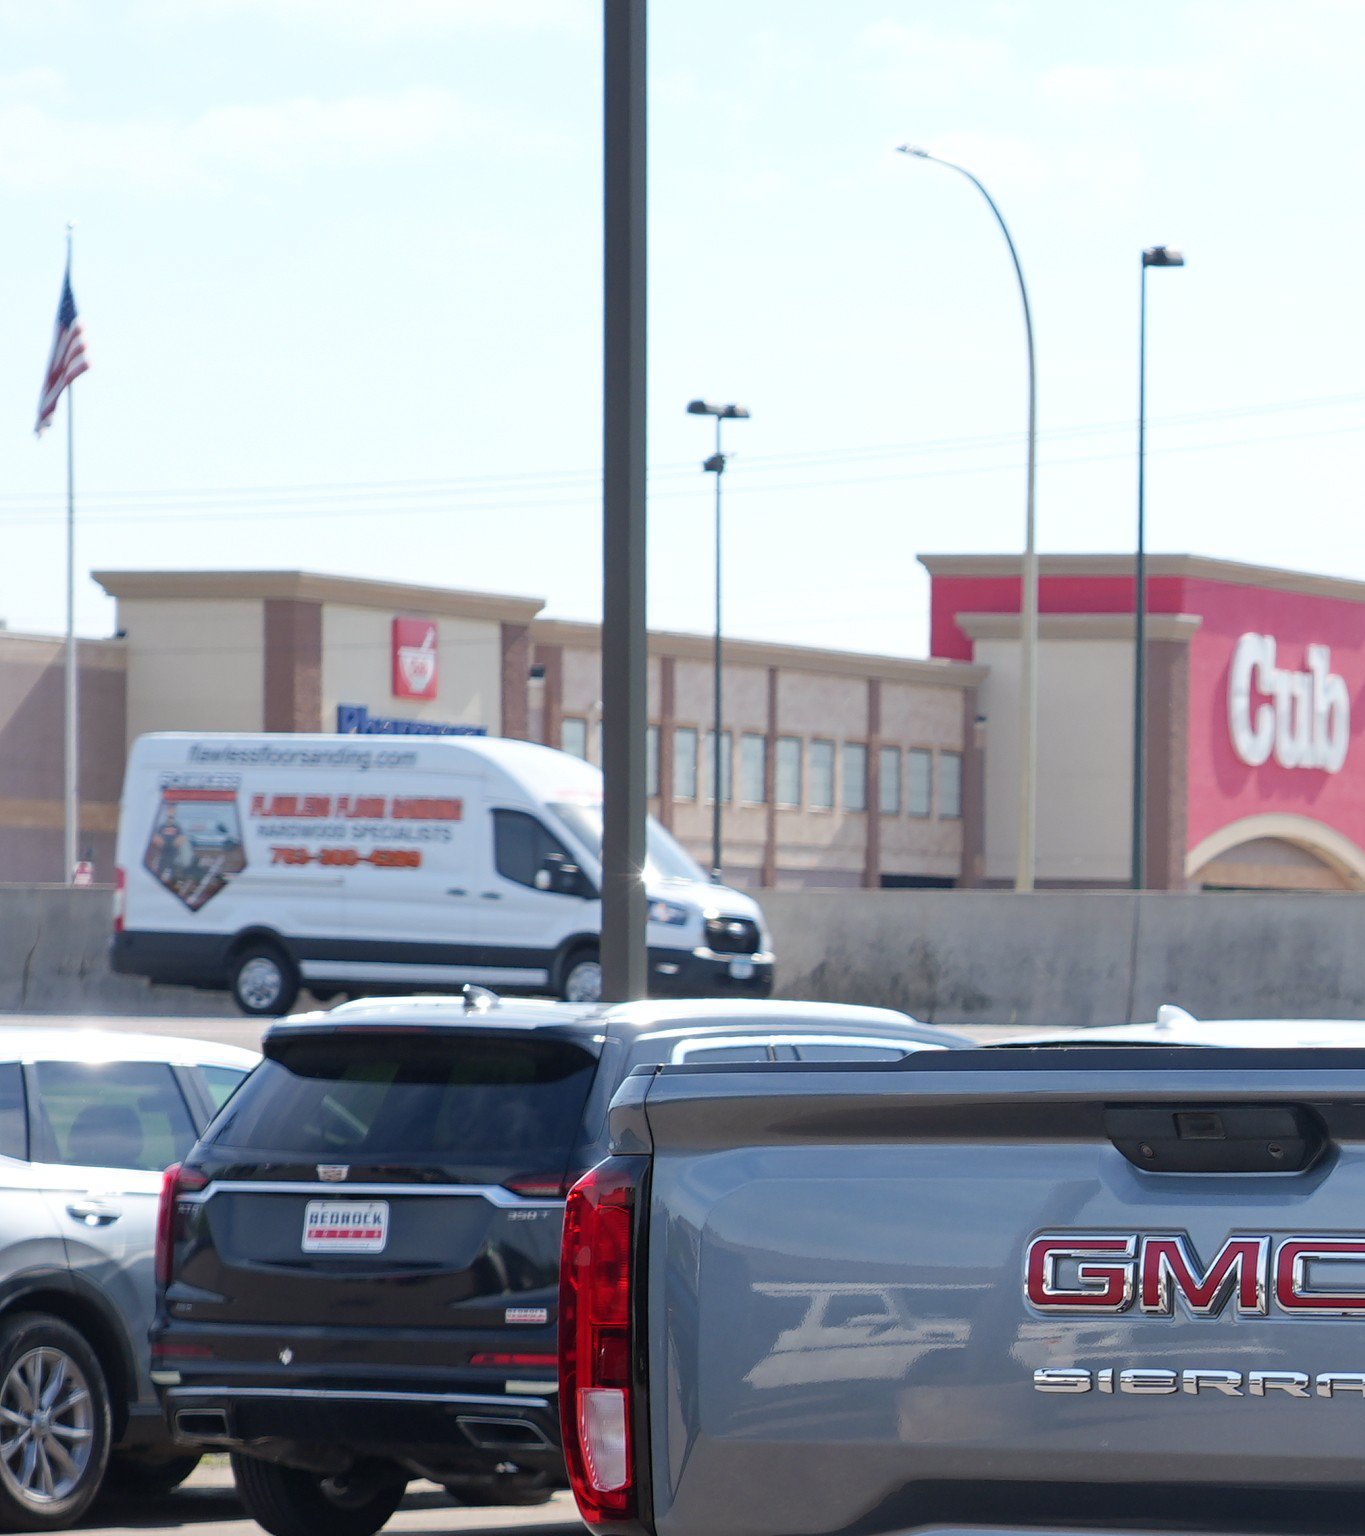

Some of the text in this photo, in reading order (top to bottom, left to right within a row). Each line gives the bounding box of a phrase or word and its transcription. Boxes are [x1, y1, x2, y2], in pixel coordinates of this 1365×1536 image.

[1227, 632, 1350, 774] Cub
[352, 826, 453, 843] SPECIALISTS
[309, 1211, 382, 1225] BEDROCK
